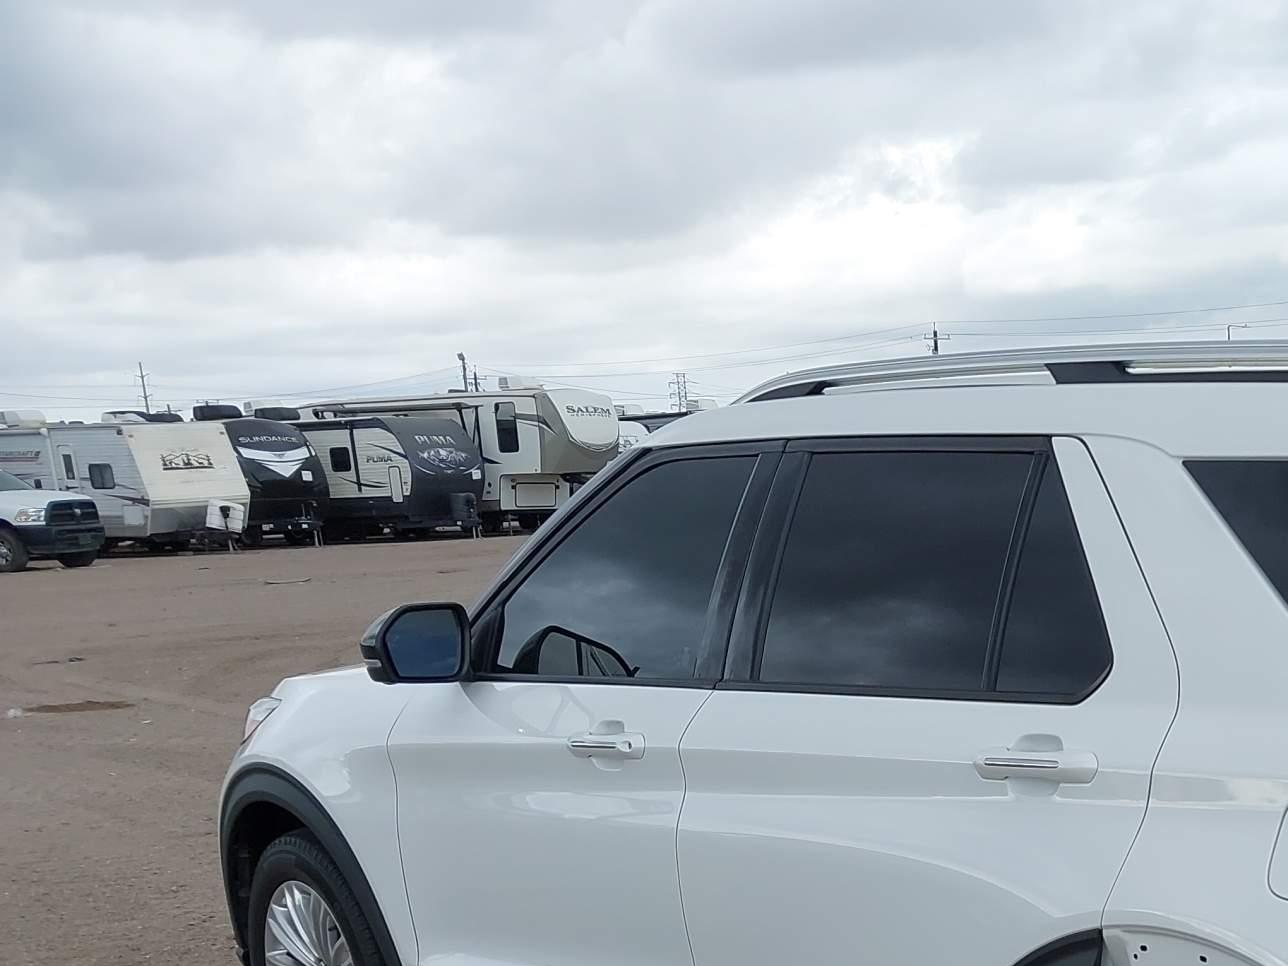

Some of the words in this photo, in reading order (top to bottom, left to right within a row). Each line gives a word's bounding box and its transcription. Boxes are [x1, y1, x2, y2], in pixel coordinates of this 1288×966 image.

[566, 404, 611, 415] SALEM
[238, 435, 300, 444] SUNDANCE
[414, 434, 456, 446] PUMA
[366, 455, 394, 464] PUMA
